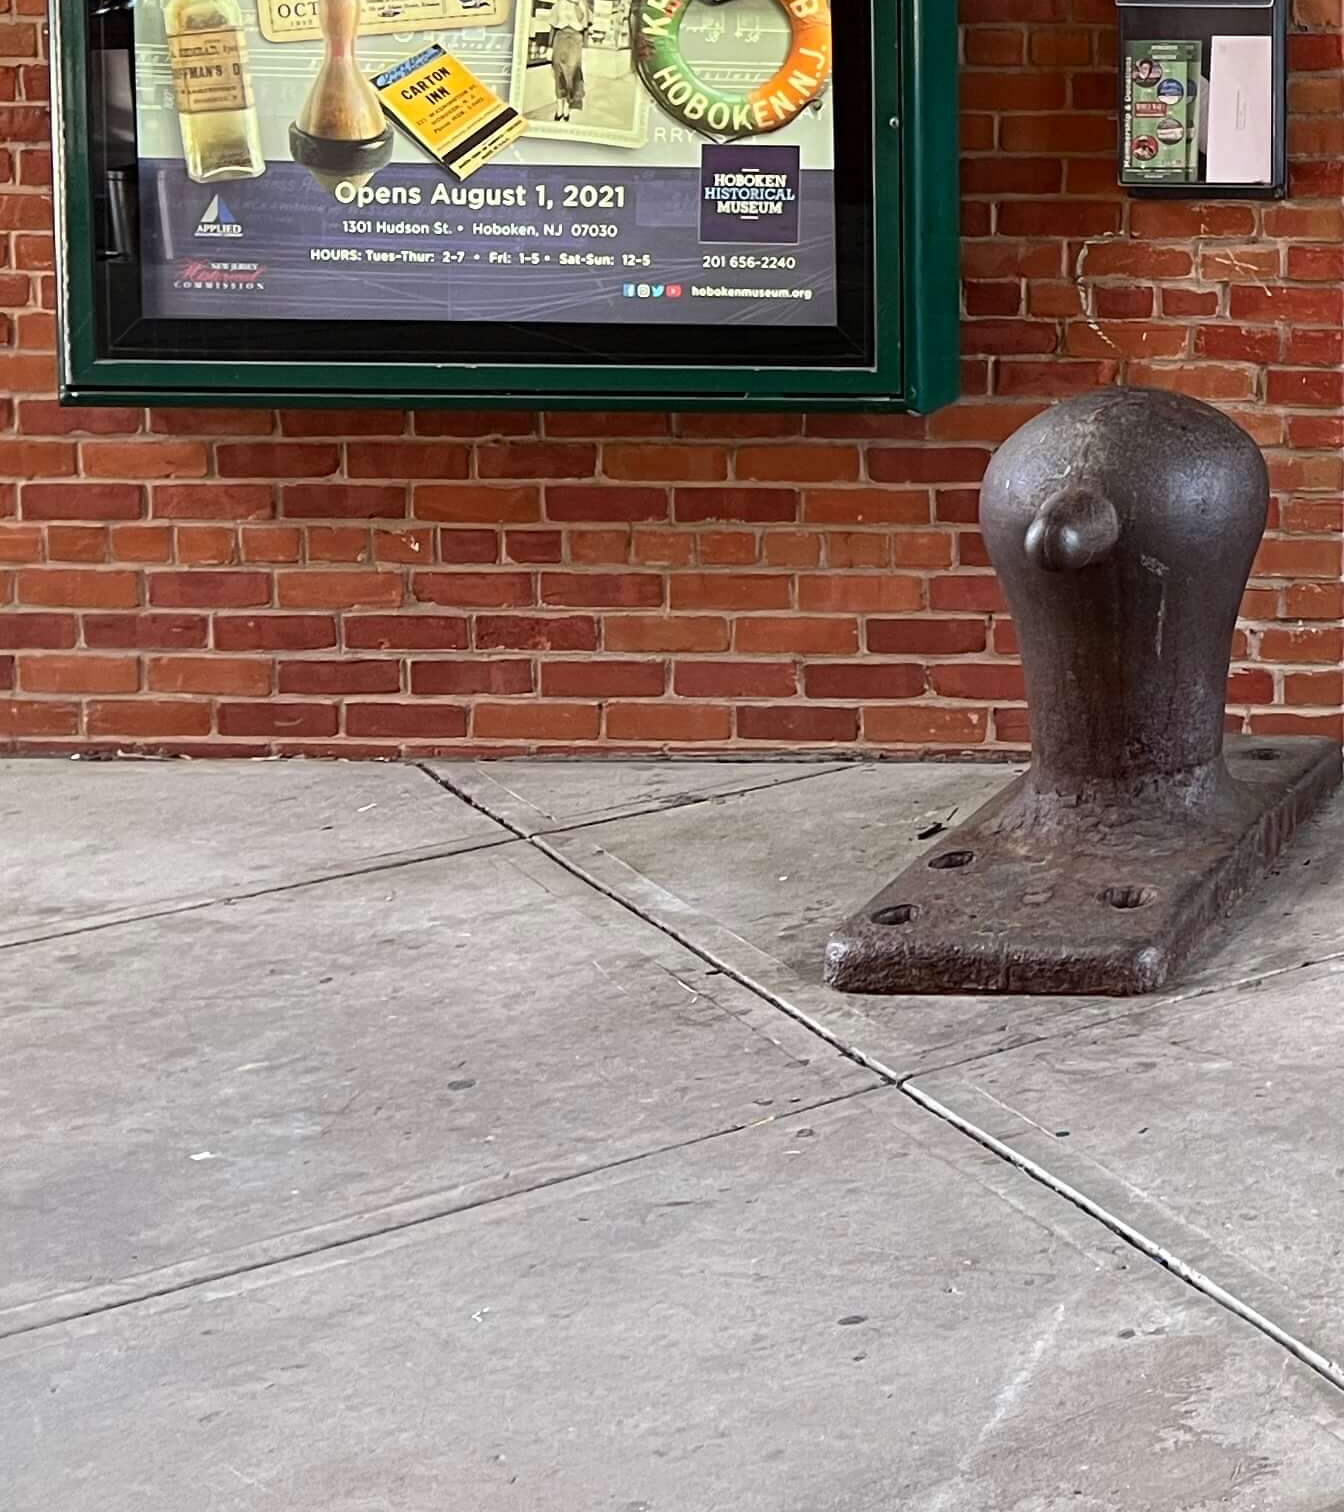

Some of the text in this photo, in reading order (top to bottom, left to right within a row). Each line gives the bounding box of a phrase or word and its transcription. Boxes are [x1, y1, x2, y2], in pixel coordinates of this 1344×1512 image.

[401, 66, 451, 101] CARTON
[425, 85, 451, 106] INN
[653, 64, 797, 131] HOBOKEN
[713, 174, 787, 188] HOBOKEN
[335, 180, 626, 211] Opens August 1, 2021
[704, 187, 795, 201] HISTORICAL
[717, 200, 784, 215] MUSEUM
[342, 220, 618, 238] 1301 Hudson St. Hoboken, NJ 07030
[310, 248, 362, 262] HOURS:
[622, 254, 652, 267] 12-5
[702, 255, 796, 270] 201 656-2240
[173, 281, 266, 291] COMMISSION
[691, 286, 813, 301] hobokenmuseum.org
